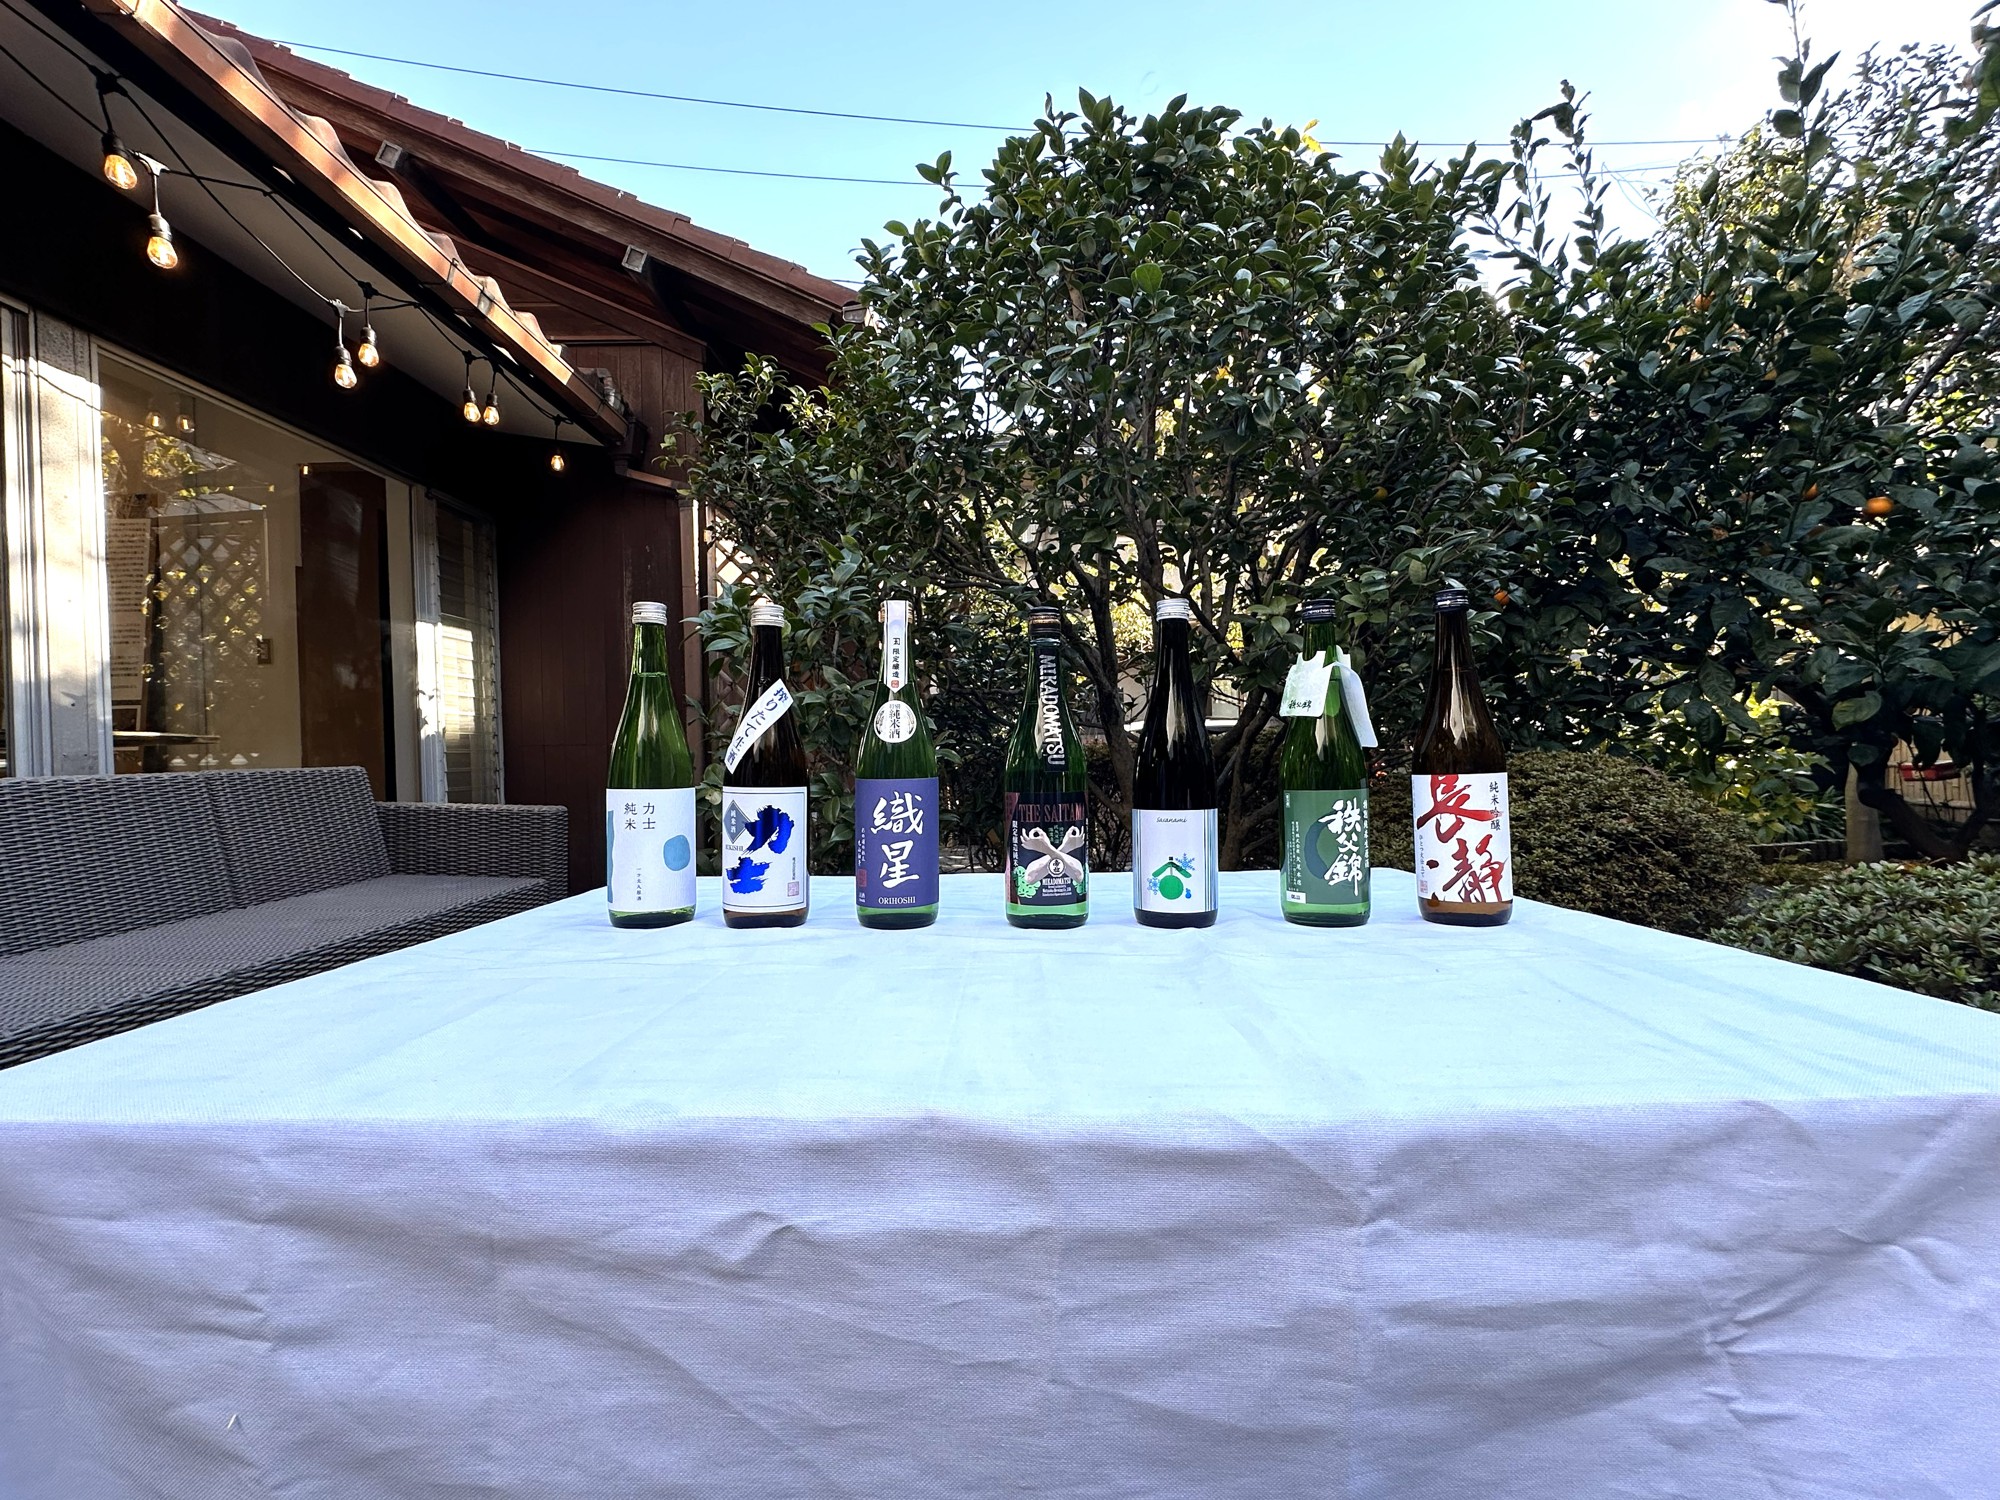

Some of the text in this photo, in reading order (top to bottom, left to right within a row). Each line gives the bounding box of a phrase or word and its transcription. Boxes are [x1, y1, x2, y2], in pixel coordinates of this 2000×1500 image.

[889, 709, 901, 739] 純米酒
[1039, 654, 1065, 765] MIKADOMATSU
[624, 802, 638, 830] 純米
[642, 802, 656, 830] 力士
[1018, 803, 1041, 822] THE
[1489, 780, 1501, 832] 純米吟醸
[870, 791, 924, 889] 織星
[1318, 797, 1363, 897] 秩父錦
[878, 896, 917, 905] ORIHOSHI
